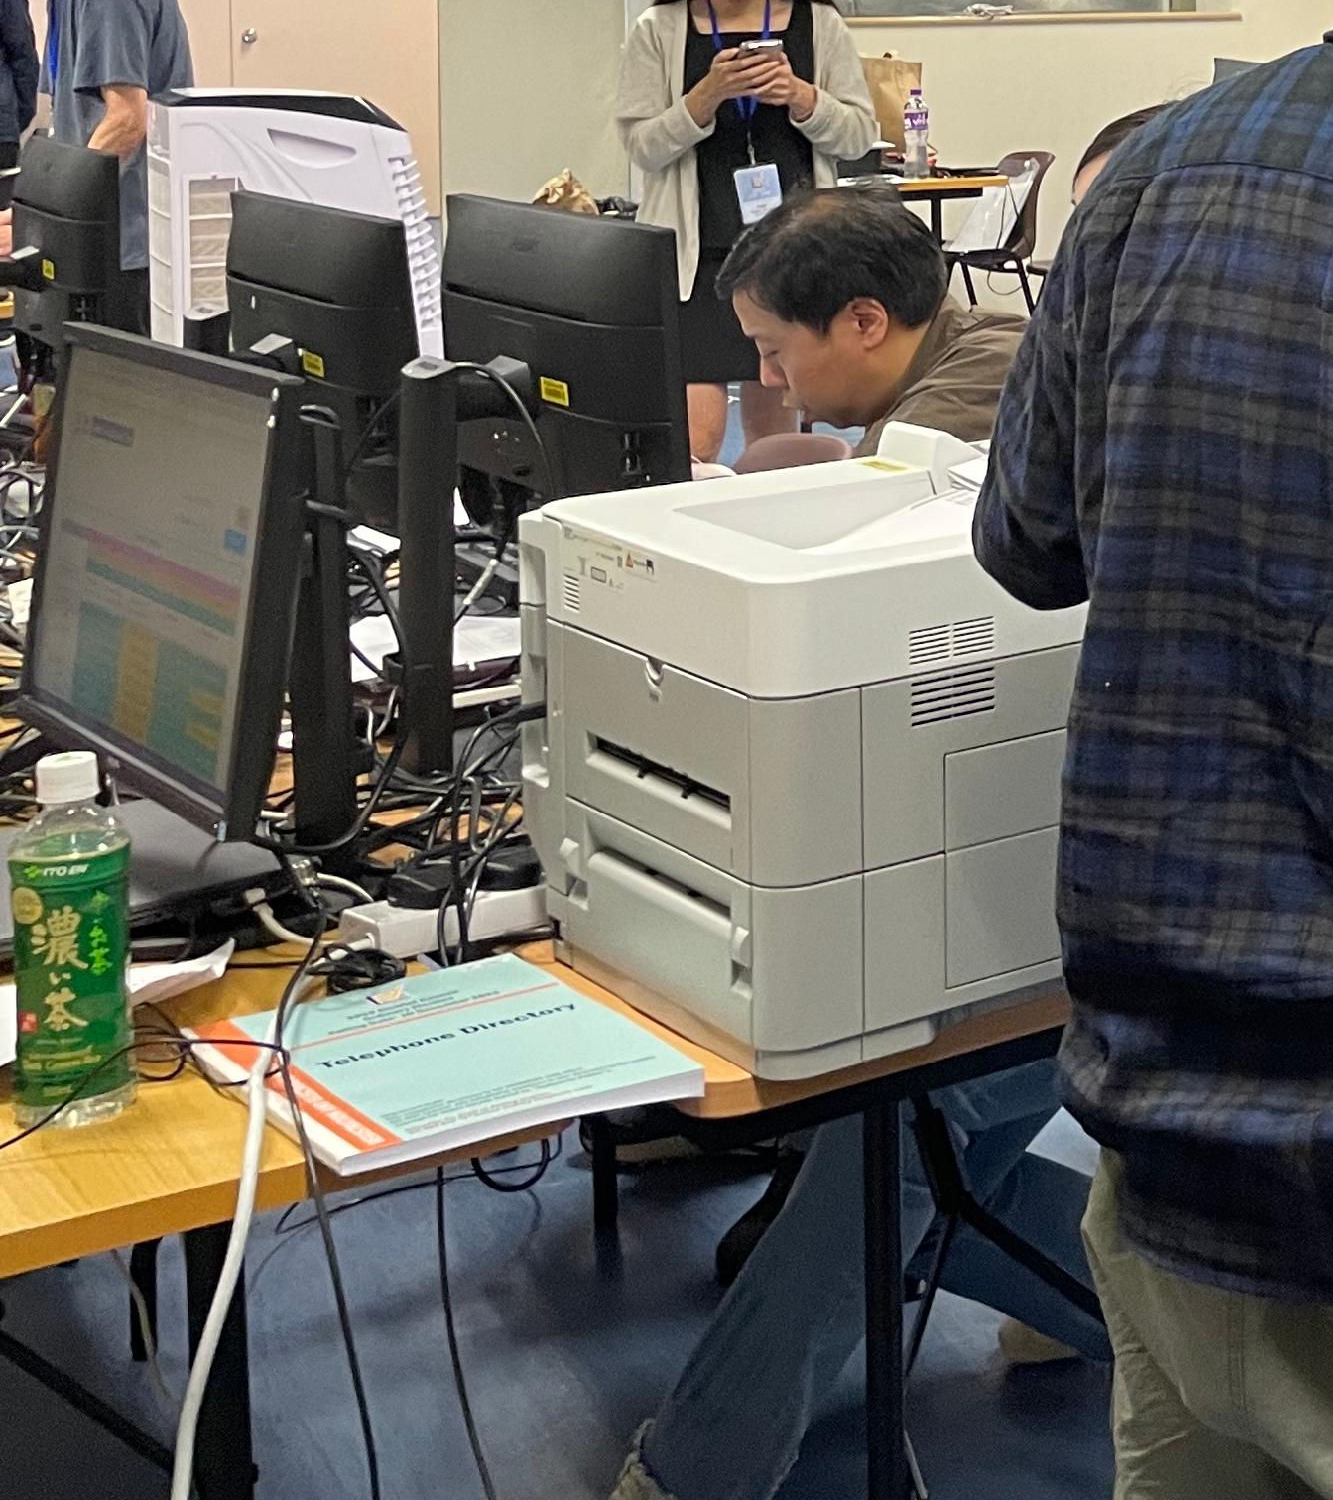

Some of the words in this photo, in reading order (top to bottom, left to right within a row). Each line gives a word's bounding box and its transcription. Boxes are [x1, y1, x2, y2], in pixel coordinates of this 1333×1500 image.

[44, 866, 67, 877] ITO
[30, 905, 89, 1033] 濃い茶
[316, 1032, 456, 1069] Telephone
[459, 1001, 577, 1035] Directory
